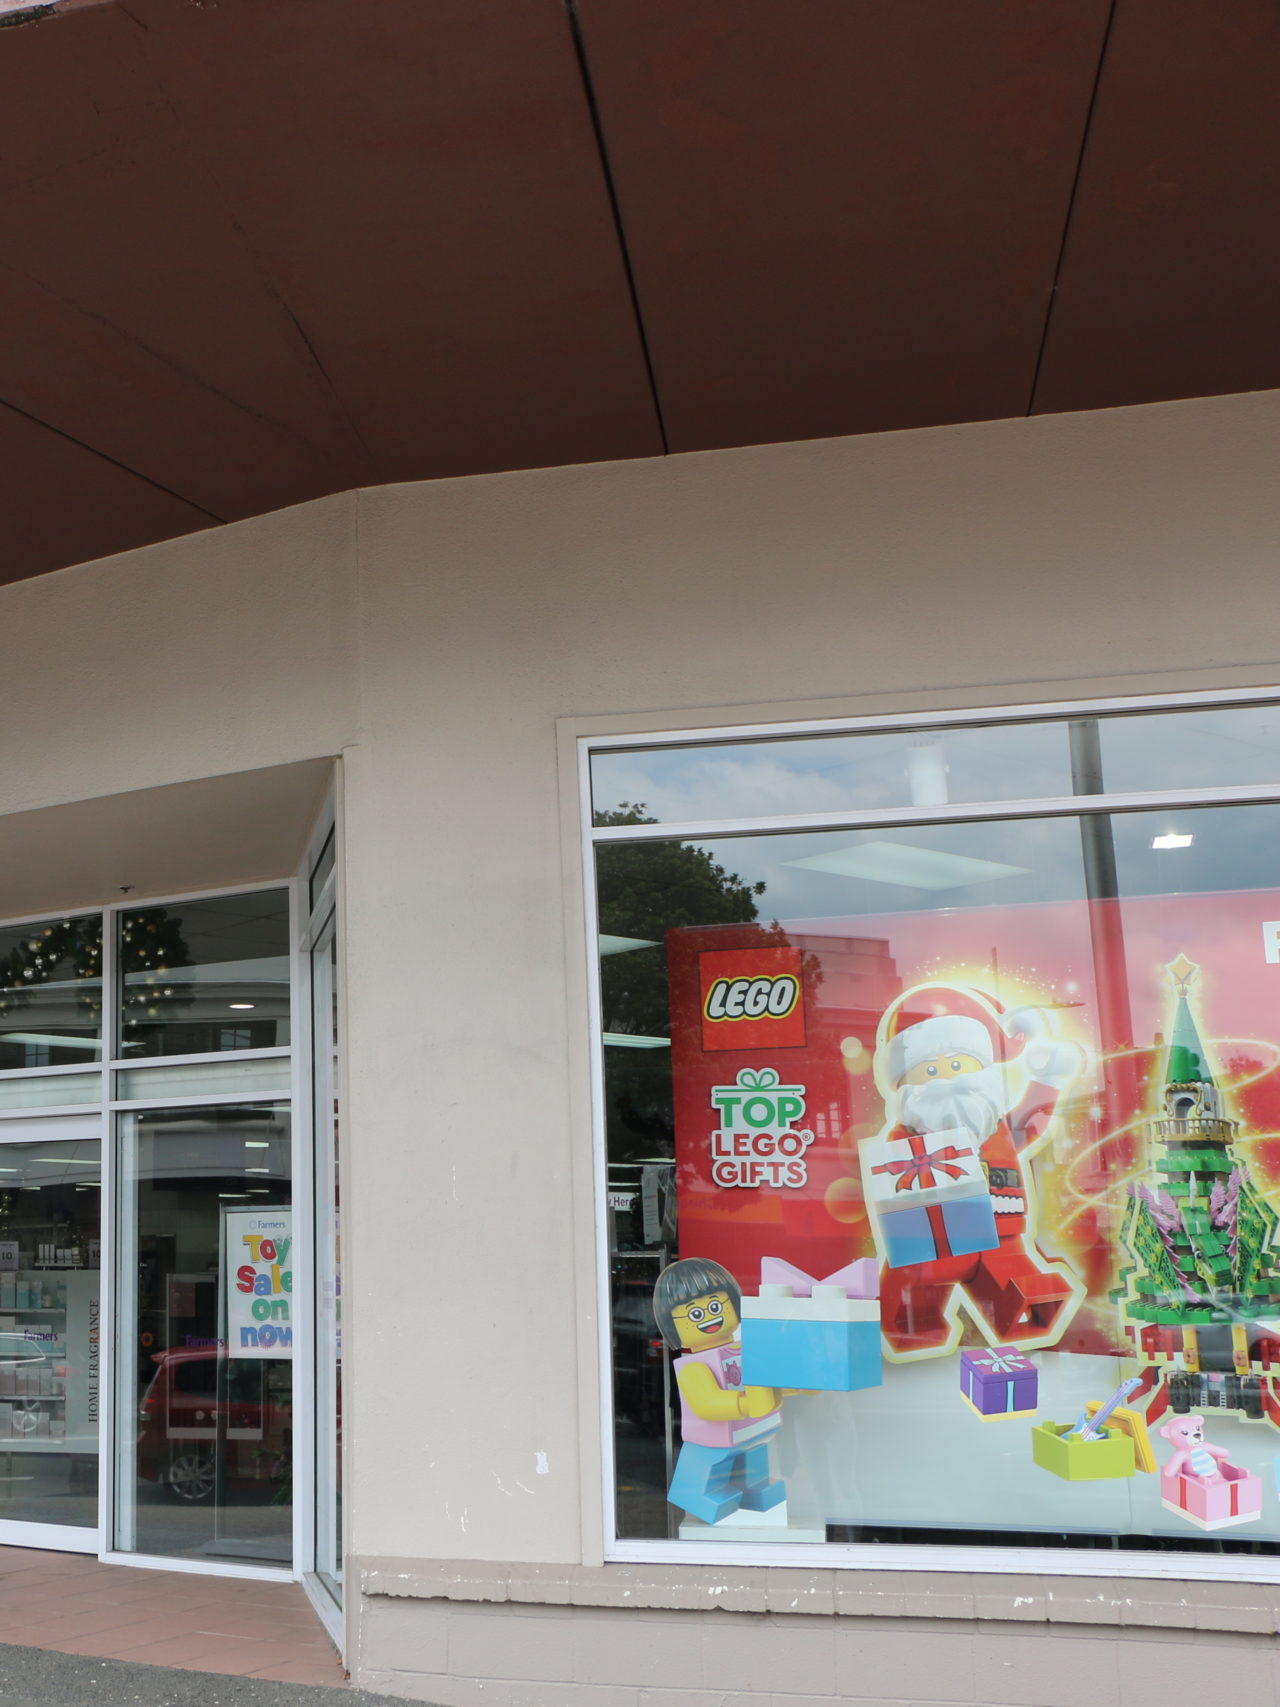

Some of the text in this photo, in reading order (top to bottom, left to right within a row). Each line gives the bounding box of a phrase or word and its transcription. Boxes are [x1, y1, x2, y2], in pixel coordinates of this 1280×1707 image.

[706, 976, 797, 1020] LEGO
[715, 1096, 802, 1128] TOP
[715, 1162, 804, 1184] GIFTS
[257, 1220, 286, 1229] Farmers
[236, 1264, 292, 1296] Sale
[251, 1298, 290, 1321] on
[24, 1329, 58, 1341] Farmers
[240, 1324, 293, 1348] now
[88, 1299, 99, 1423] HOME FRAGRANCE
